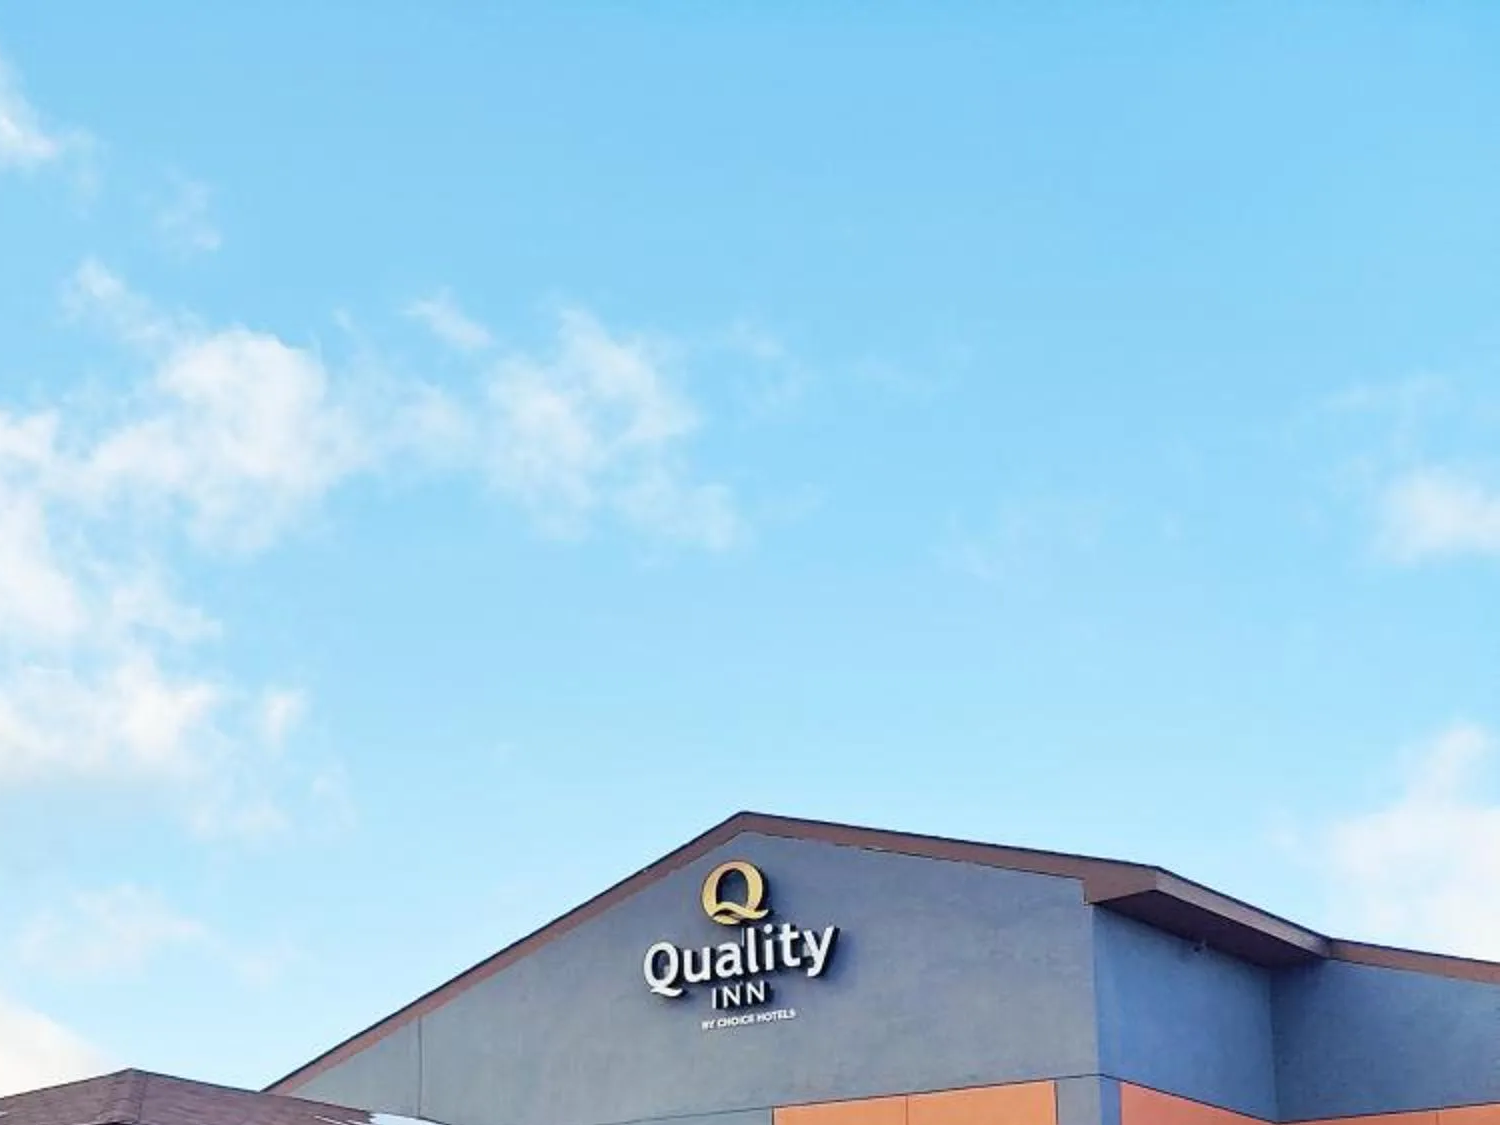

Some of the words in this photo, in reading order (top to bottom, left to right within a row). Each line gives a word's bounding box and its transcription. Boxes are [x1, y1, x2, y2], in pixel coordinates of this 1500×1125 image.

[702, 860, 769, 925] Q
[643, 922, 839, 998] Quality
[711, 980, 766, 1009] INN
[756, 1008, 796, 1024] HOTELS
